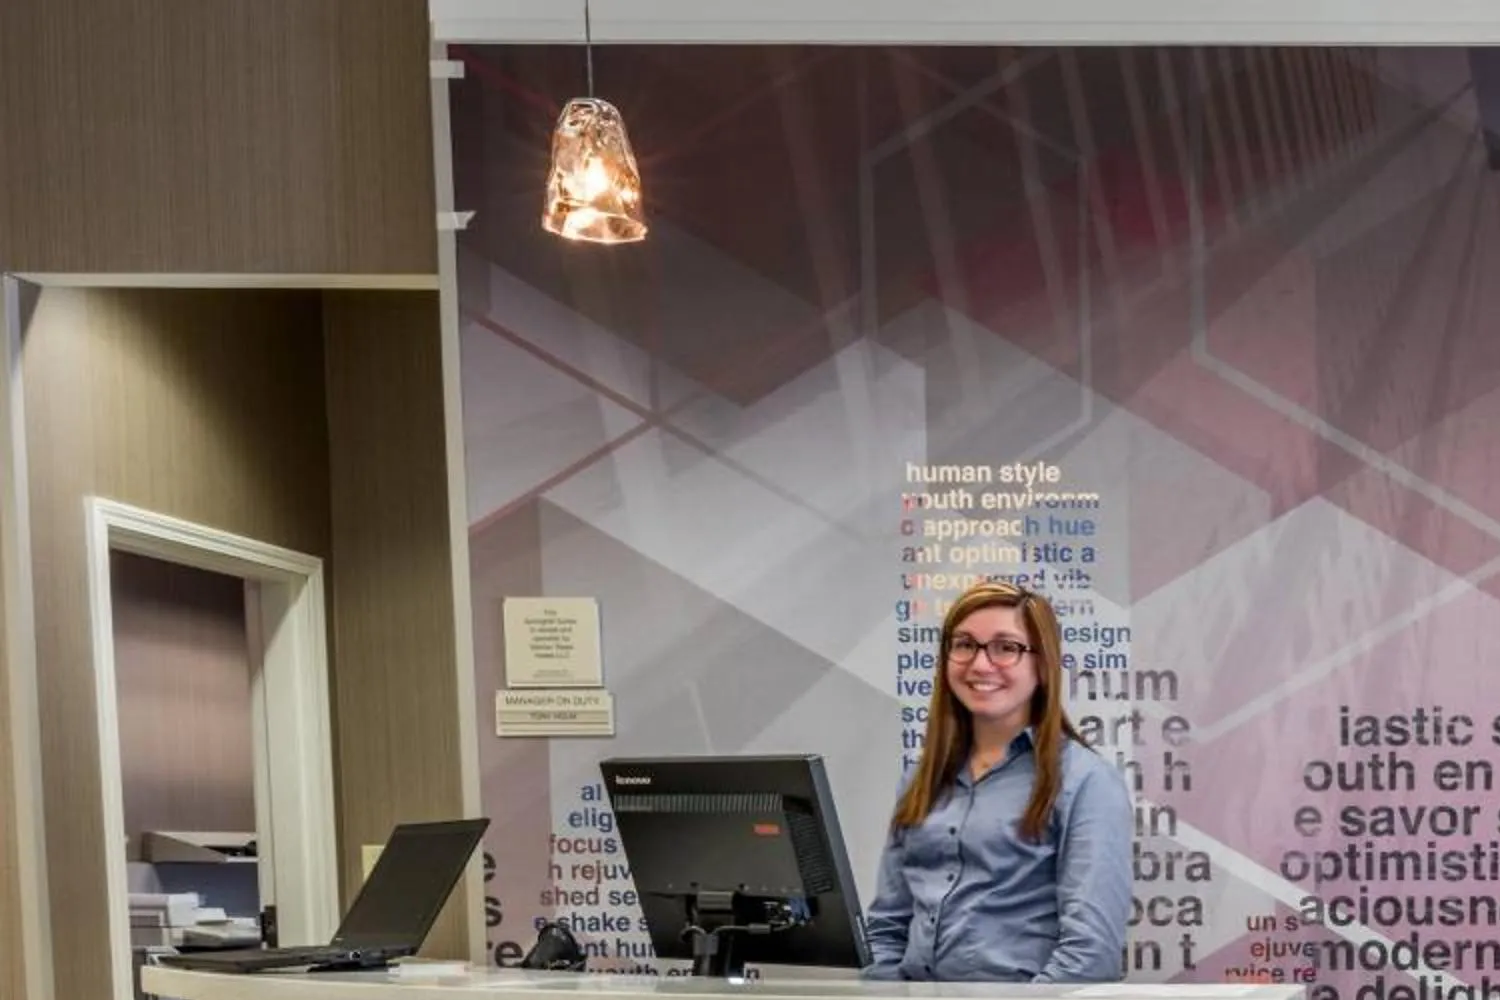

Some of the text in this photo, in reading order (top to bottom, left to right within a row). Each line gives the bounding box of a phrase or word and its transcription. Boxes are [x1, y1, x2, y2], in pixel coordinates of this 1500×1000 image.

[906, 461, 1061, 488] human style
[923, 517, 1040, 542] approach
[1049, 516, 1095, 536] hue
[903, 542, 1095, 570] ant optimistic a
[1083, 652, 1127, 669] sim
[1162, 715, 1190, 747] e
[1340, 706, 1474, 747] iastic
[1303, 751, 1493, 793] outh en
[568, 808, 613, 832] elig
[1294, 806, 1322, 837] e
[1340, 805, 1480, 837] savor
[549, 834, 617, 854] focus
[548, 861, 562, 880] h
[540, 887, 599, 906] shed
[1247, 915, 1298, 931] un s
[1179, 933, 1196, 971] t
[1293, 967, 1316, 982] re
